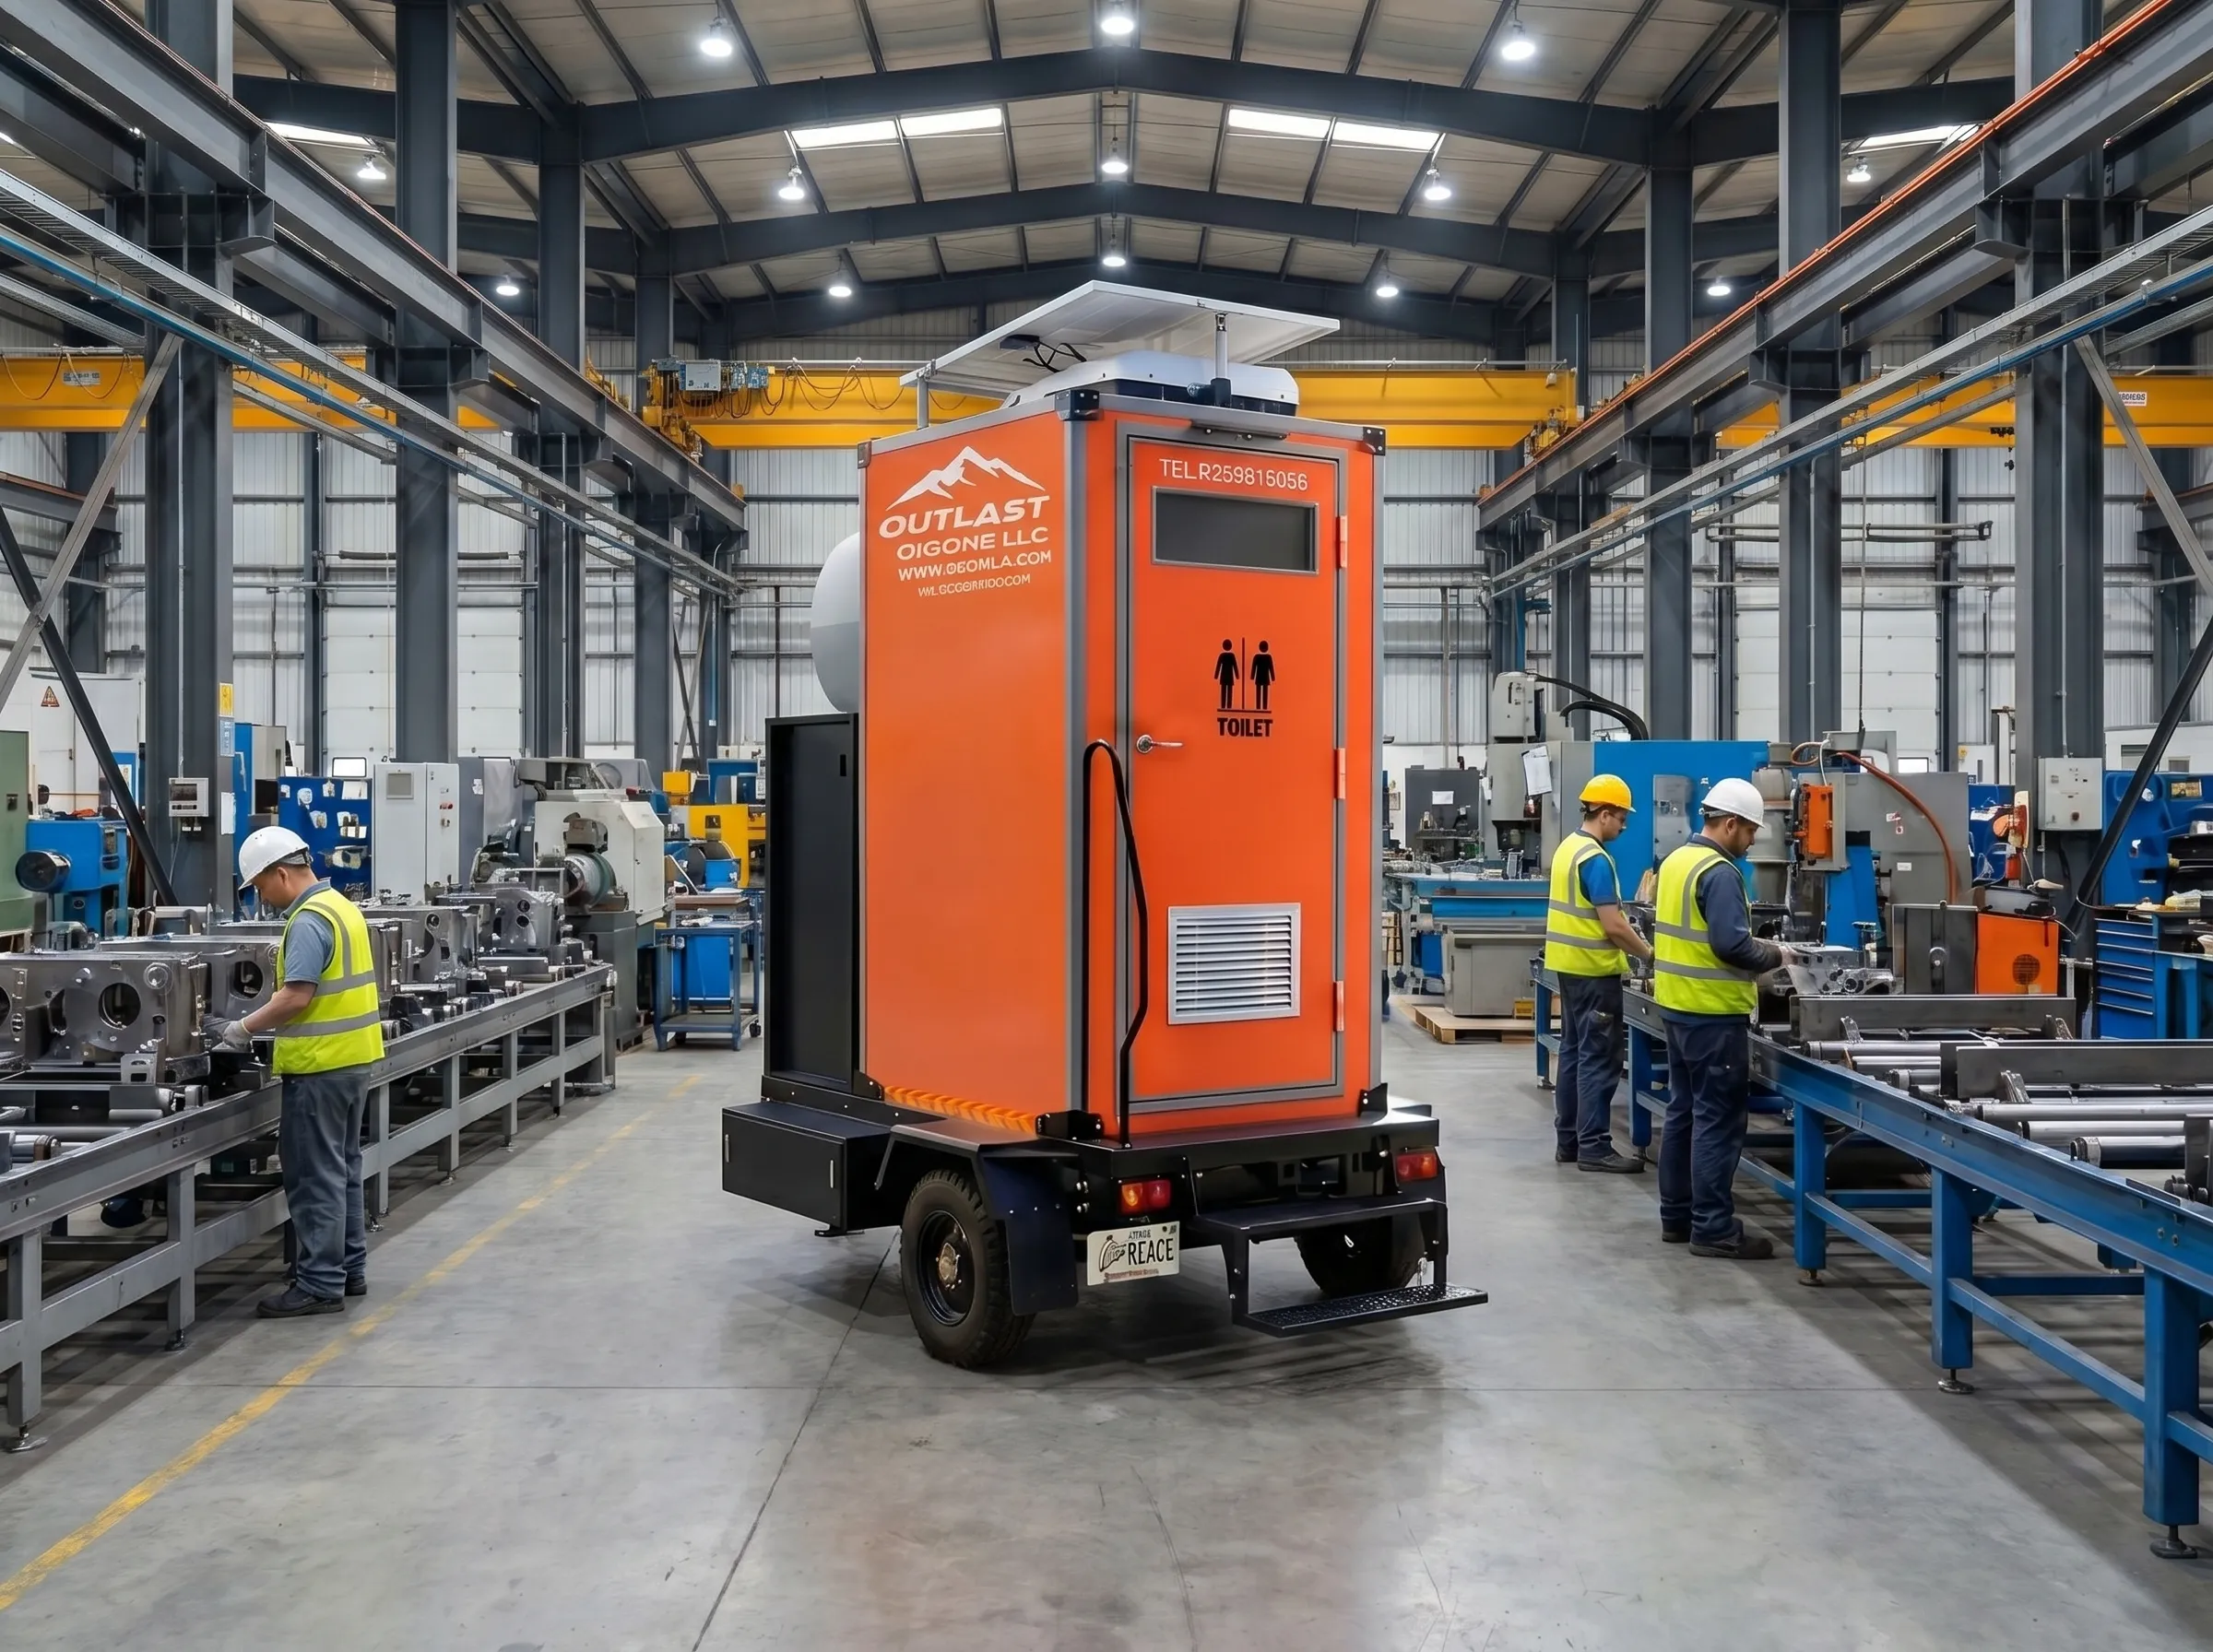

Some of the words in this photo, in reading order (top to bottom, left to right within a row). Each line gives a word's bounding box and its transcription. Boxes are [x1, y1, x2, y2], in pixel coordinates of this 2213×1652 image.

[879, 495, 1050, 538] OUTLAST
[896, 533, 996, 560] OIGONE
[1002, 526, 1049, 548] LLC
[1217, 717, 1273, 738] TOILET
[1128, 1238, 1174, 1266] REACE
